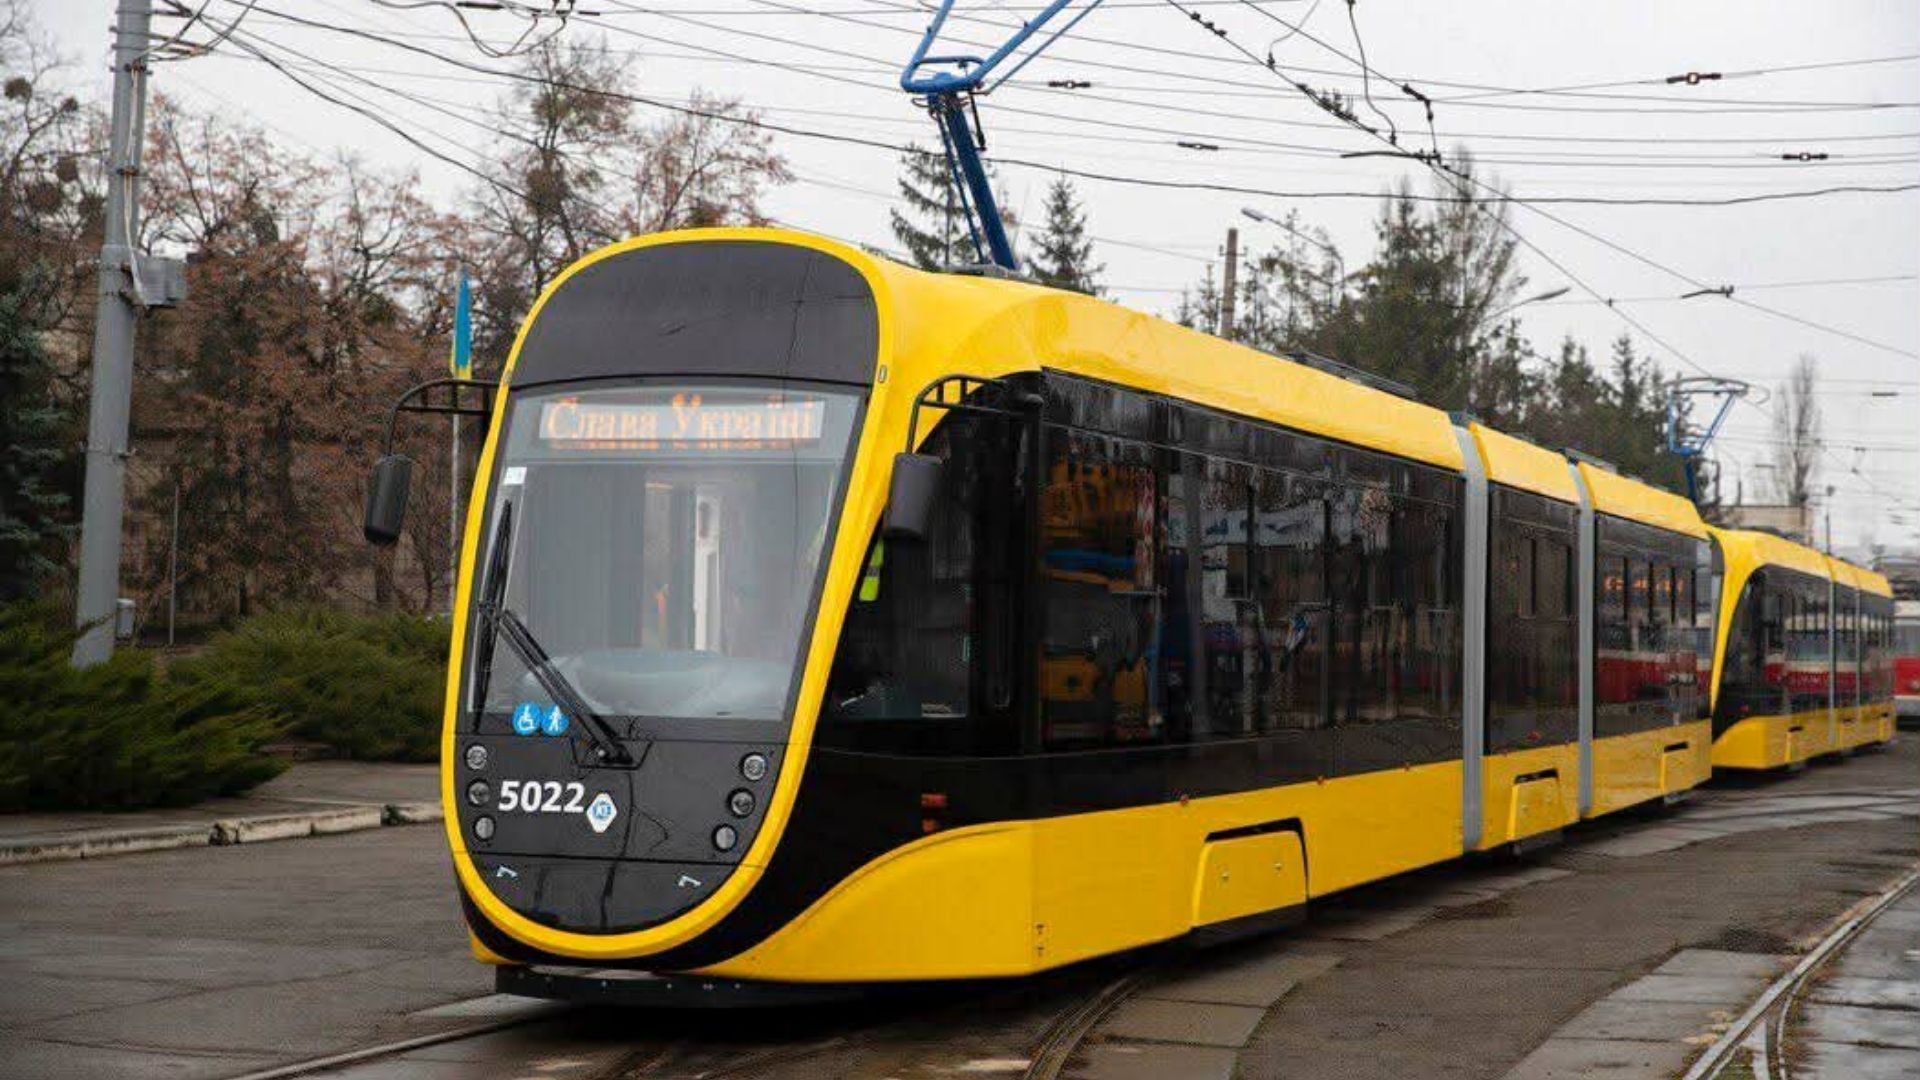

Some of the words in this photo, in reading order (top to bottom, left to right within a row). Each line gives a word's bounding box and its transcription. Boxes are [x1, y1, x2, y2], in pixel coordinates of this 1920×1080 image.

[548, 397, 659, 448] Слава
[671, 394, 815, 448] Україні
[498, 780, 585, 812] 5022
